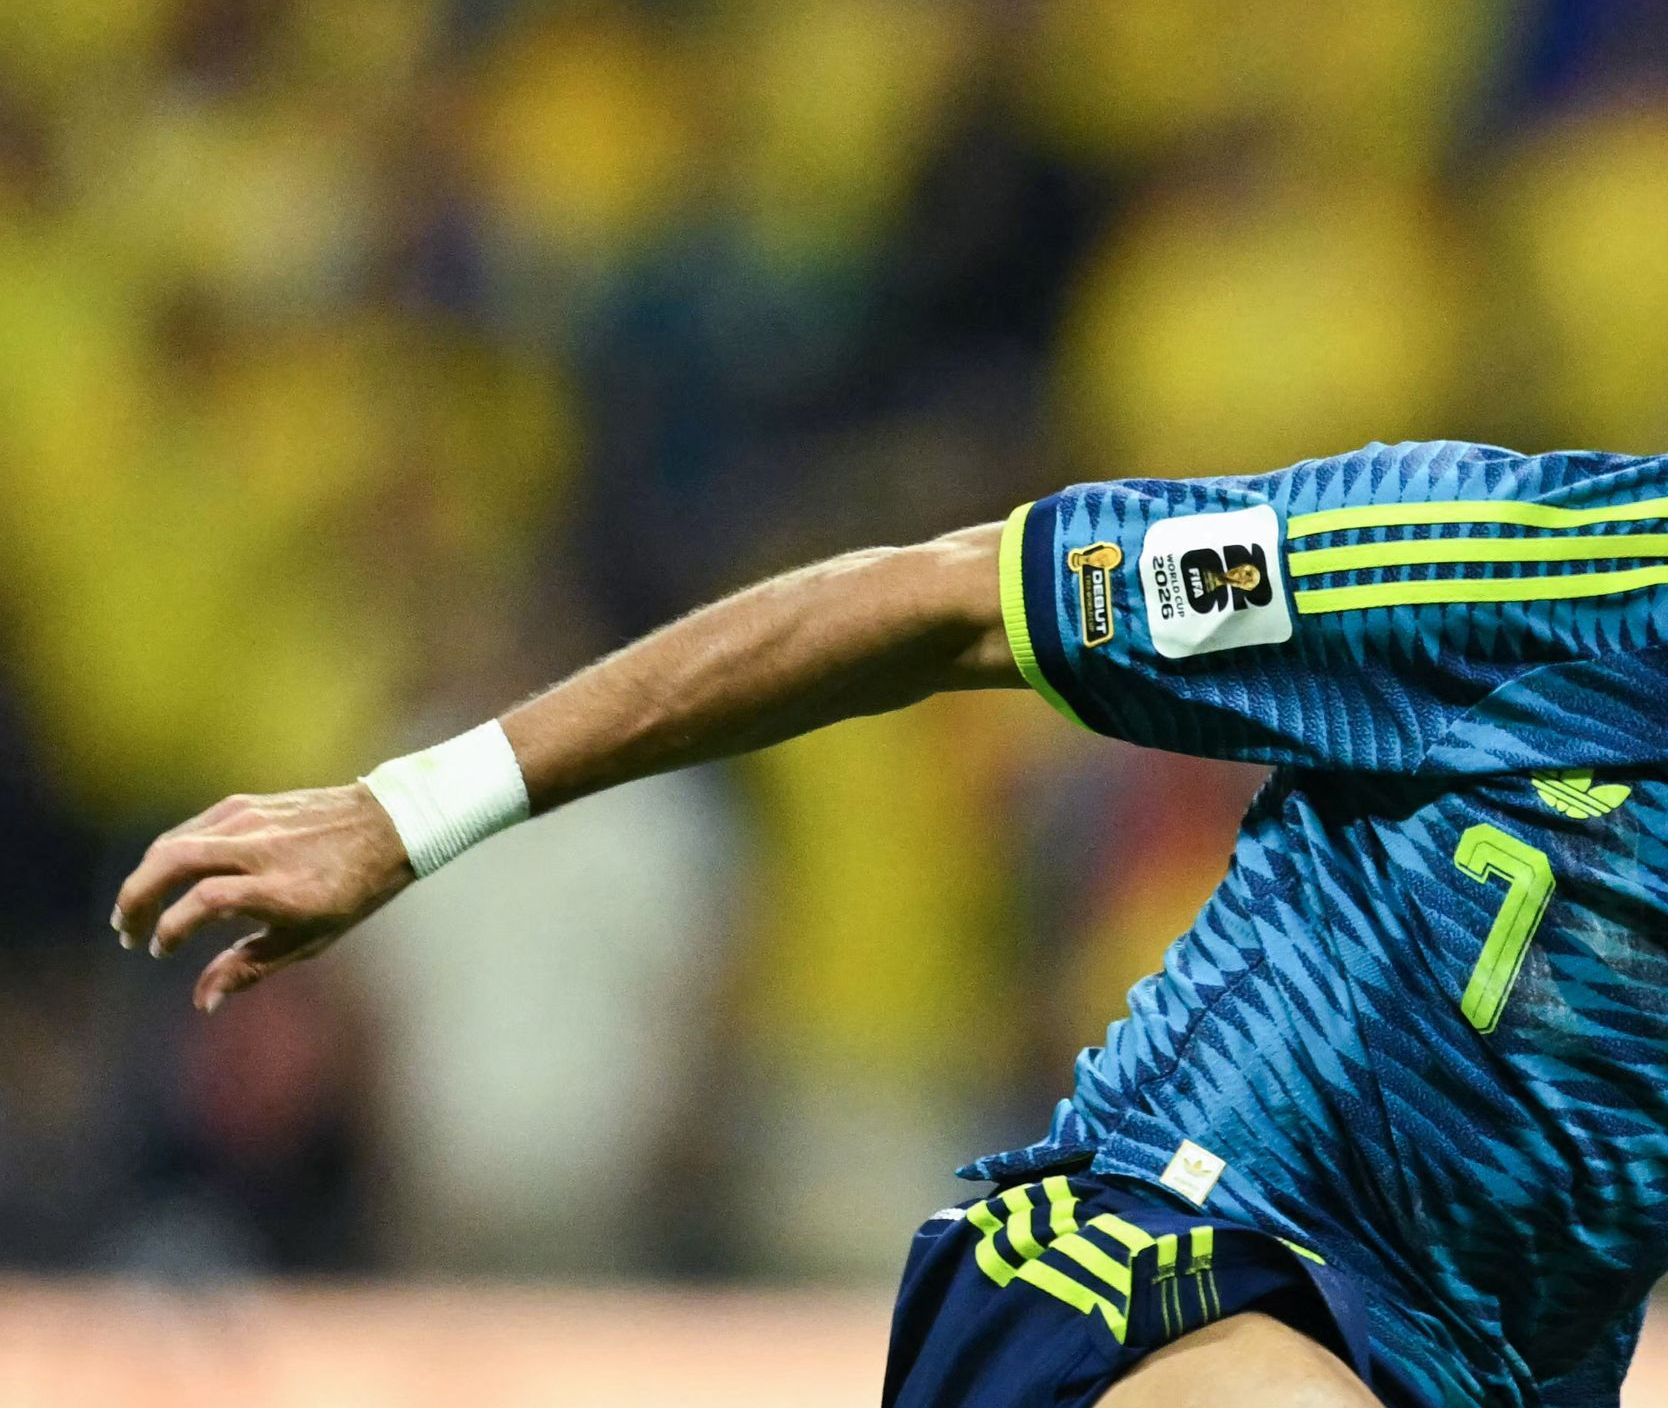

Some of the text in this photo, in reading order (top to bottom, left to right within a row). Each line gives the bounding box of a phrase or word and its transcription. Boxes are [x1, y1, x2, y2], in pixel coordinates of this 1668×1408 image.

[1092, 570, 1107, 634] DEBUT
[1152, 556, 1174, 620] 2026
[1167, 554, 1185, 618] WORLD CUP
[1188, 567, 1204, 599] FIFA
[1453, 823, 1556, 1035] 7
